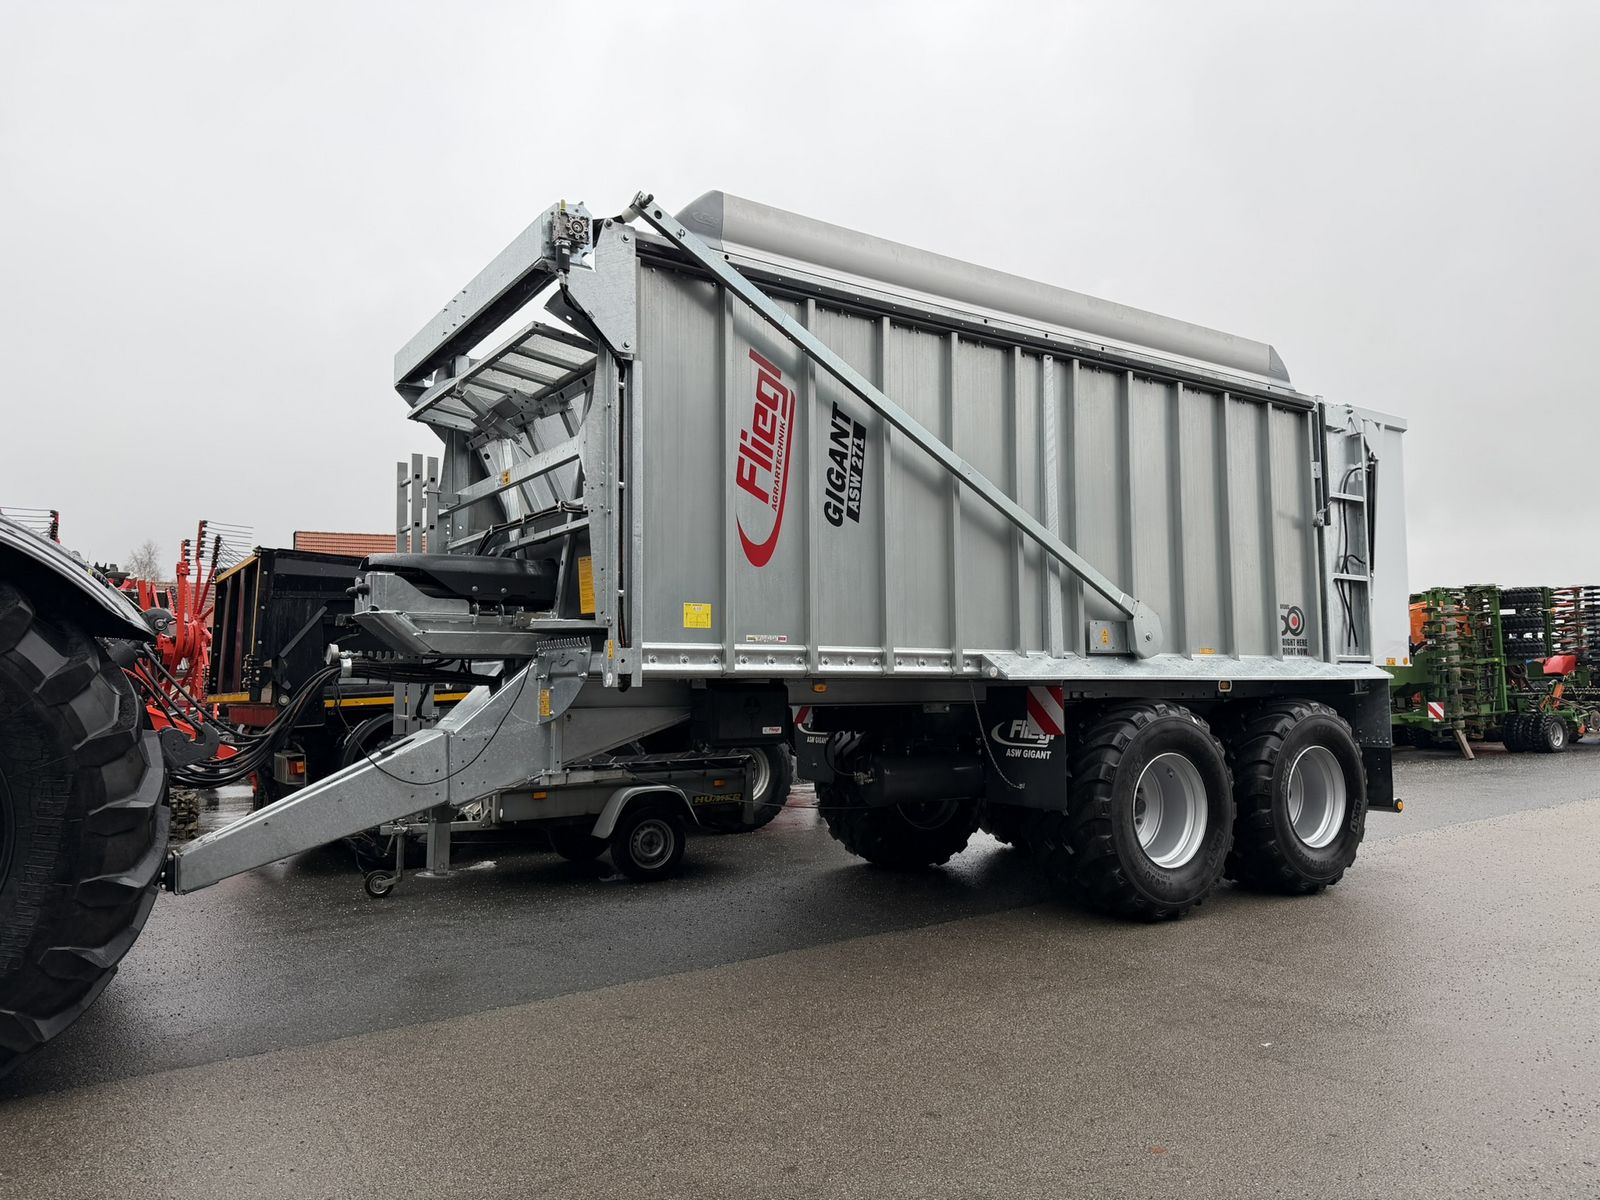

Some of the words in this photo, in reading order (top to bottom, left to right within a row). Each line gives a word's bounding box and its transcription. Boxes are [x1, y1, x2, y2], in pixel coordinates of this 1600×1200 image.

[736, 348, 788, 505] Fliegl
[771, 420, 787, 512] AGRARTECHNIK
[823, 400, 851, 527] GIGANT
[851, 437, 865, 470] 271
[848, 470, 862, 513] ASW
[1282, 638, 1295, 646] RIGHT
[1296, 638, 1308, 647] HERE
[1282, 647, 1296, 655] RIGHT
[1006, 748, 1022, 757] ASW
[1022, 749, 1052, 760] GIGANT
